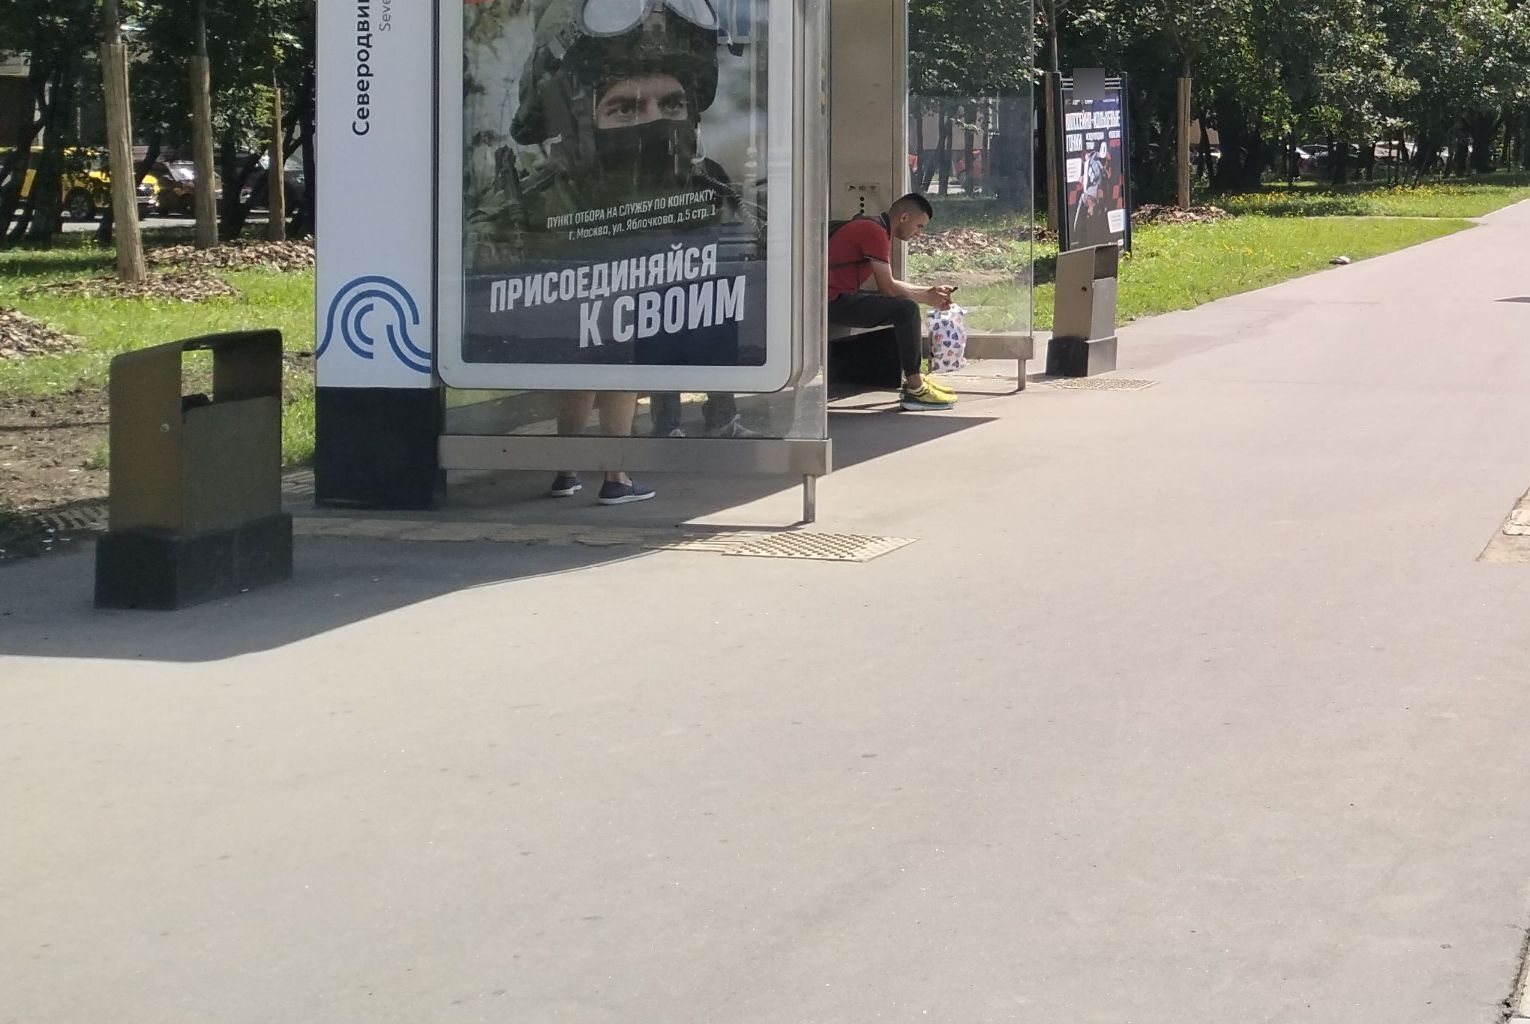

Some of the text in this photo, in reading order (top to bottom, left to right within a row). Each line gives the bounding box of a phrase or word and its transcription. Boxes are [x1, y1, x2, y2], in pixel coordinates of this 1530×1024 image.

[546, 188, 716, 229] ПУНКТ ОТБОРА НА СЛУЖБУ ПО КОНТРАКТУ:
[568, 231, 575, 241] г.
[576, 225, 611, 239] Москва,
[612, 223, 625, 236] ул.
[626, 214, 676, 231] Яблочкова,
[691, 208, 709, 220] стр.
[710, 204, 716, 216] 1
[490, 242, 717, 313] ПРИСОЕДИНЯЙСЯ
[579, 275, 746, 348] К СВОИМ
